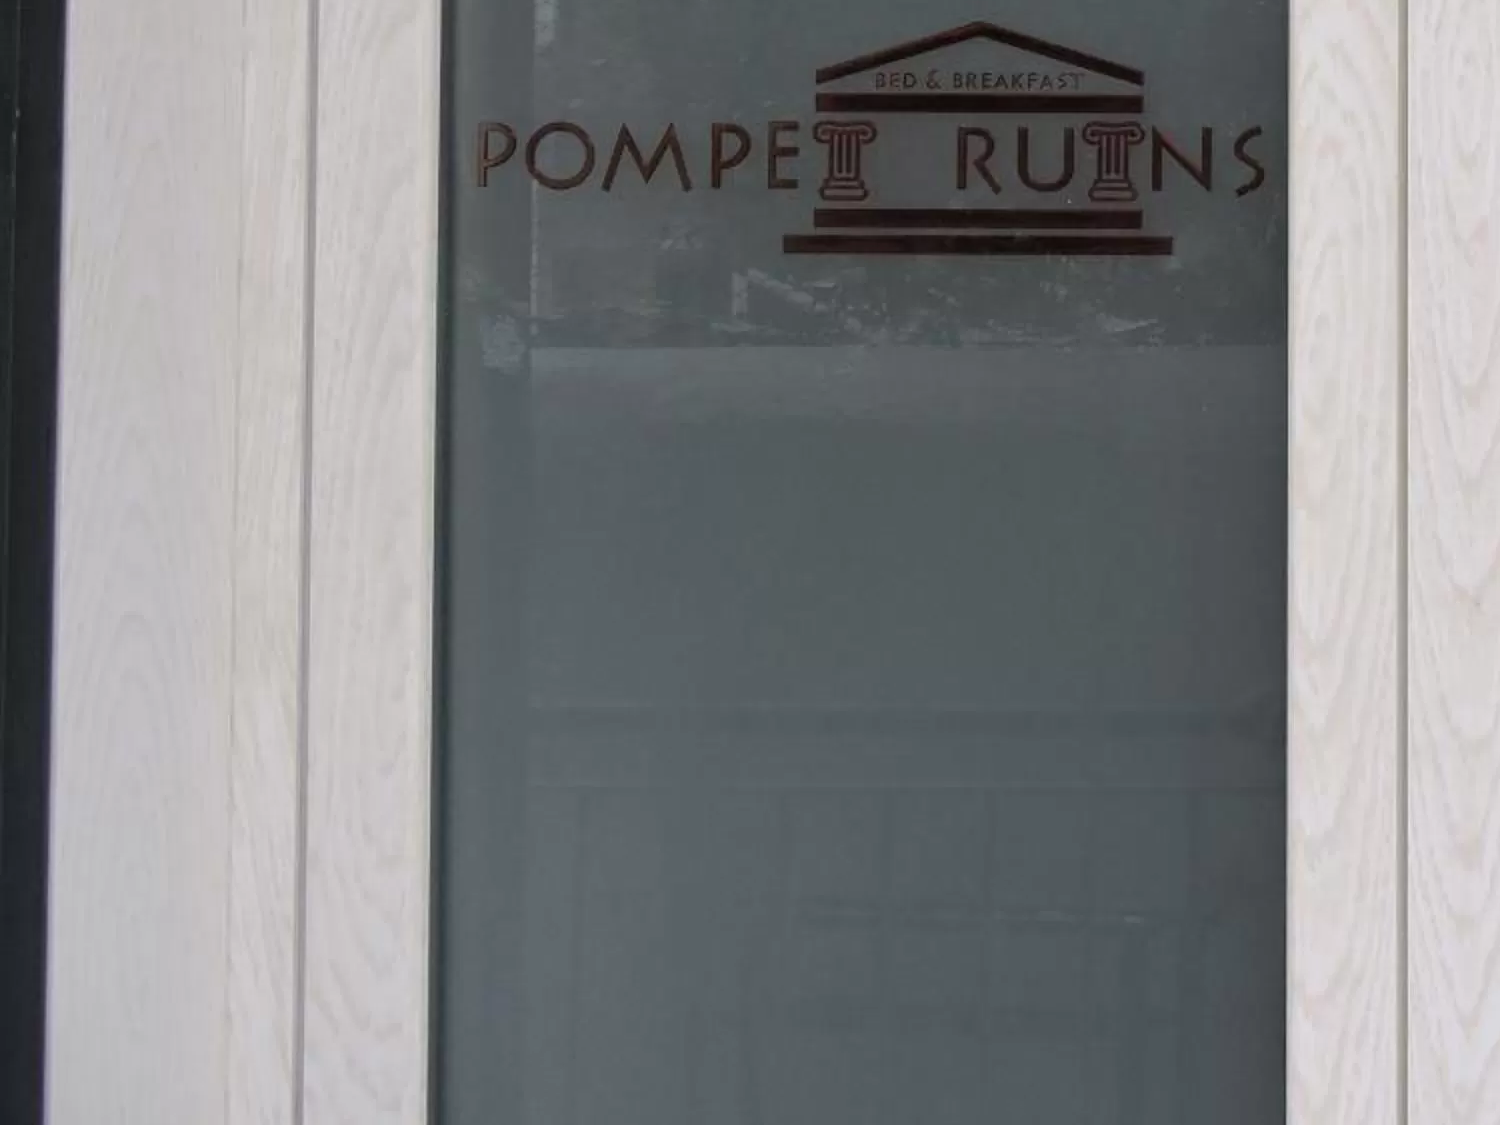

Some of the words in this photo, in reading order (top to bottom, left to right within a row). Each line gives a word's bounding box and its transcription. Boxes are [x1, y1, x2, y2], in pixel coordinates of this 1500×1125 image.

[875, 71, 918, 90] BED
[925, 71, 943, 90] &
[952, 72, 1085, 90] BREAKFAST
